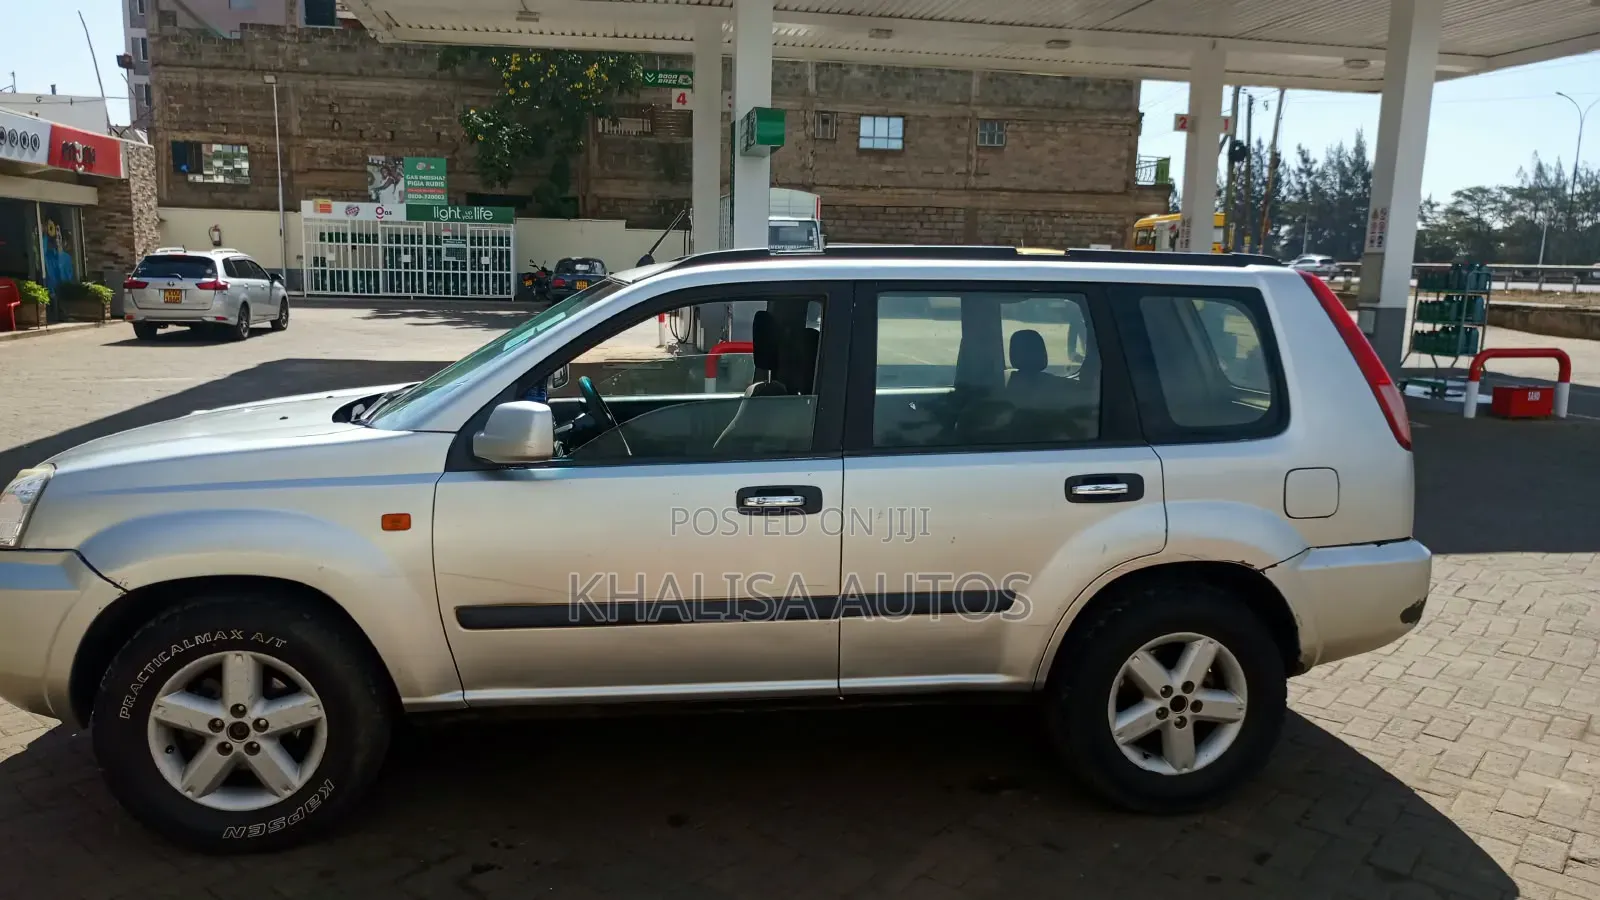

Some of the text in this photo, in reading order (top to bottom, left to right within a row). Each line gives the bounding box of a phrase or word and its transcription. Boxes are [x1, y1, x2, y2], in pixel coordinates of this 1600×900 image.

[676, 92, 687, 105] 4
[1178, 116, 1188, 129] 2
[1223, 118, 1229, 131] 1
[433, 205, 461, 221] light
[474, 206, 493, 221] life
[119, 628, 288, 720] PRACTICALMAX A/T
